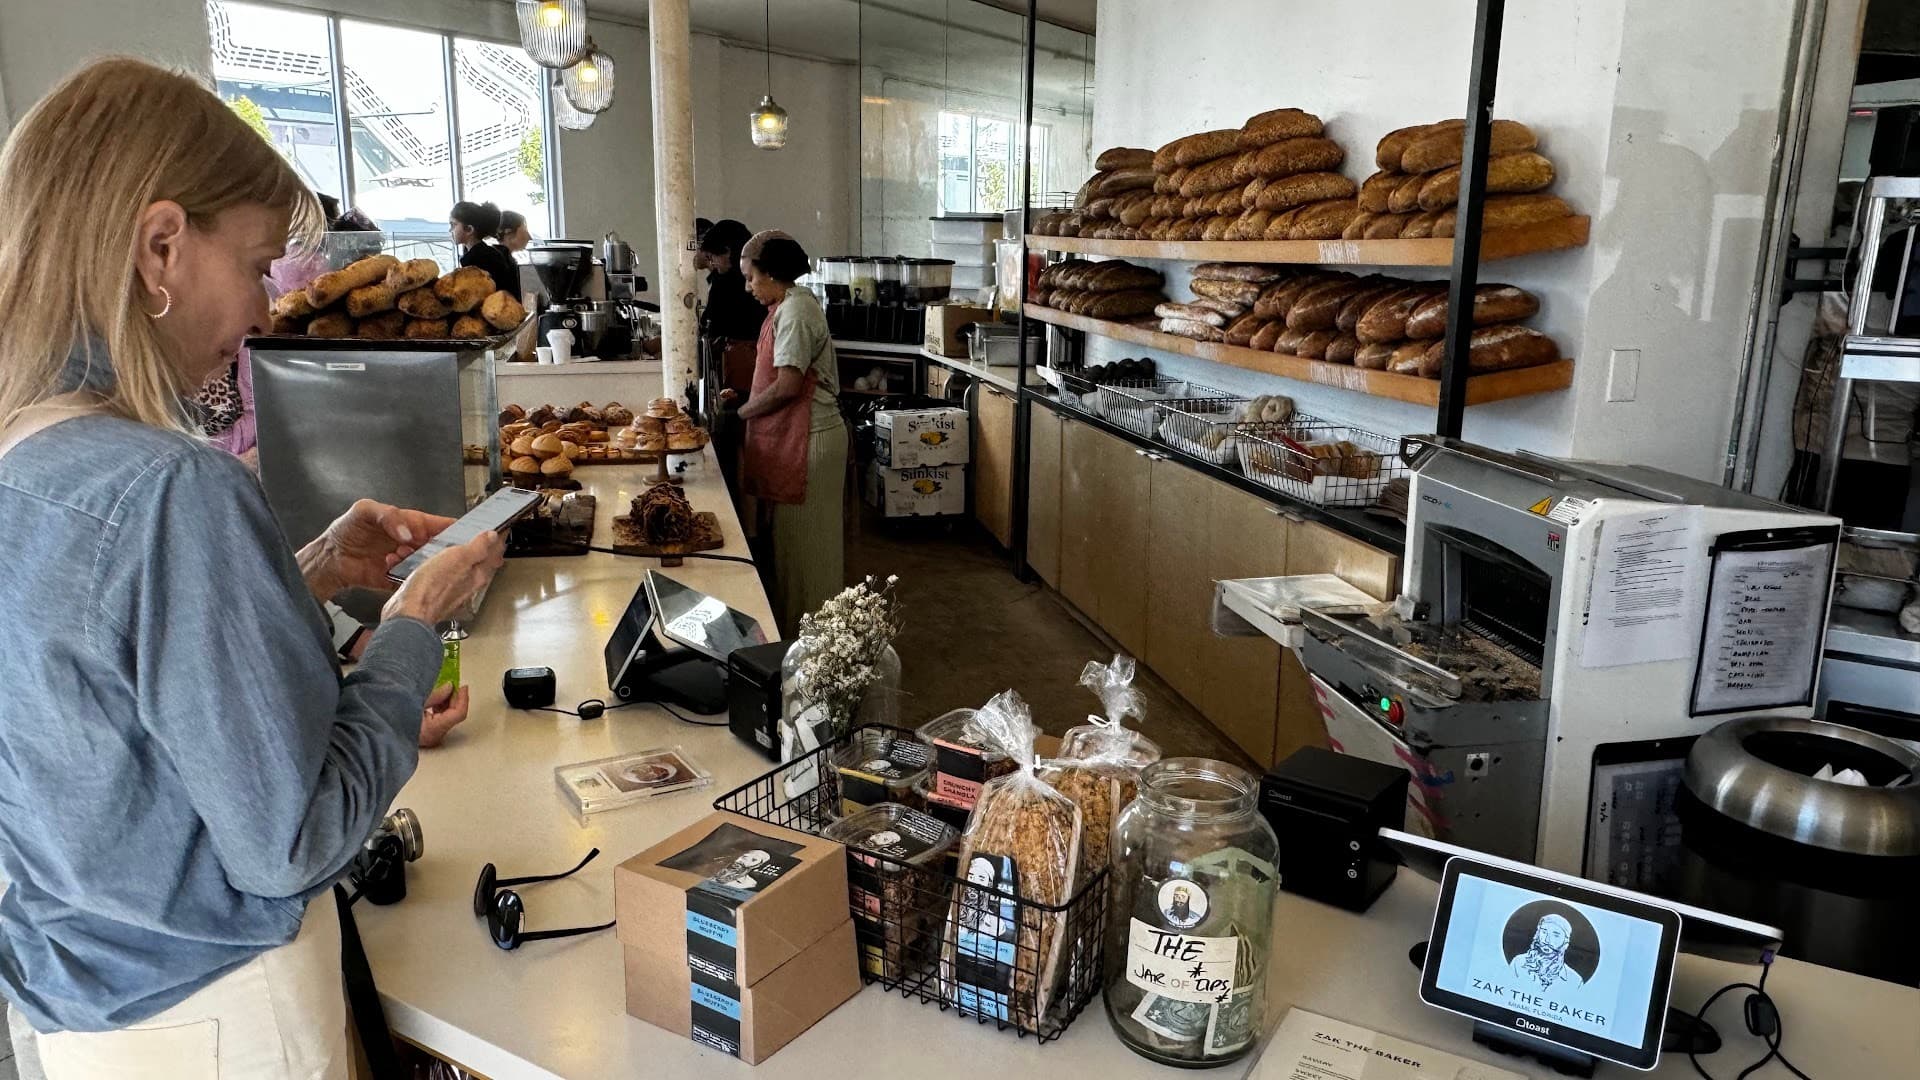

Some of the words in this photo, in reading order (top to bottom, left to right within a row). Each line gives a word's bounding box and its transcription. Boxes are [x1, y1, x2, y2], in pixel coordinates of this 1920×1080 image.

[908, 418, 956, 433] Skist
[1148, 929, 1206, 961] THE
[1134, 963, 1166, 986] JAR
[1170, 978, 1190, 990] OF
[1194, 977, 1230, 992] TIPS
[1472, 978, 1504, 997] ZAK
[1510, 988, 1543, 1008] THE
[1549, 1001, 1606, 1026] BAKER
[1525, 1020, 1550, 1036] toast
[1314, 1031, 1341, 1044] ZAK
[1345, 1040, 1372, 1054] THE
[1375, 1048, 1423, 1068] BAKER
